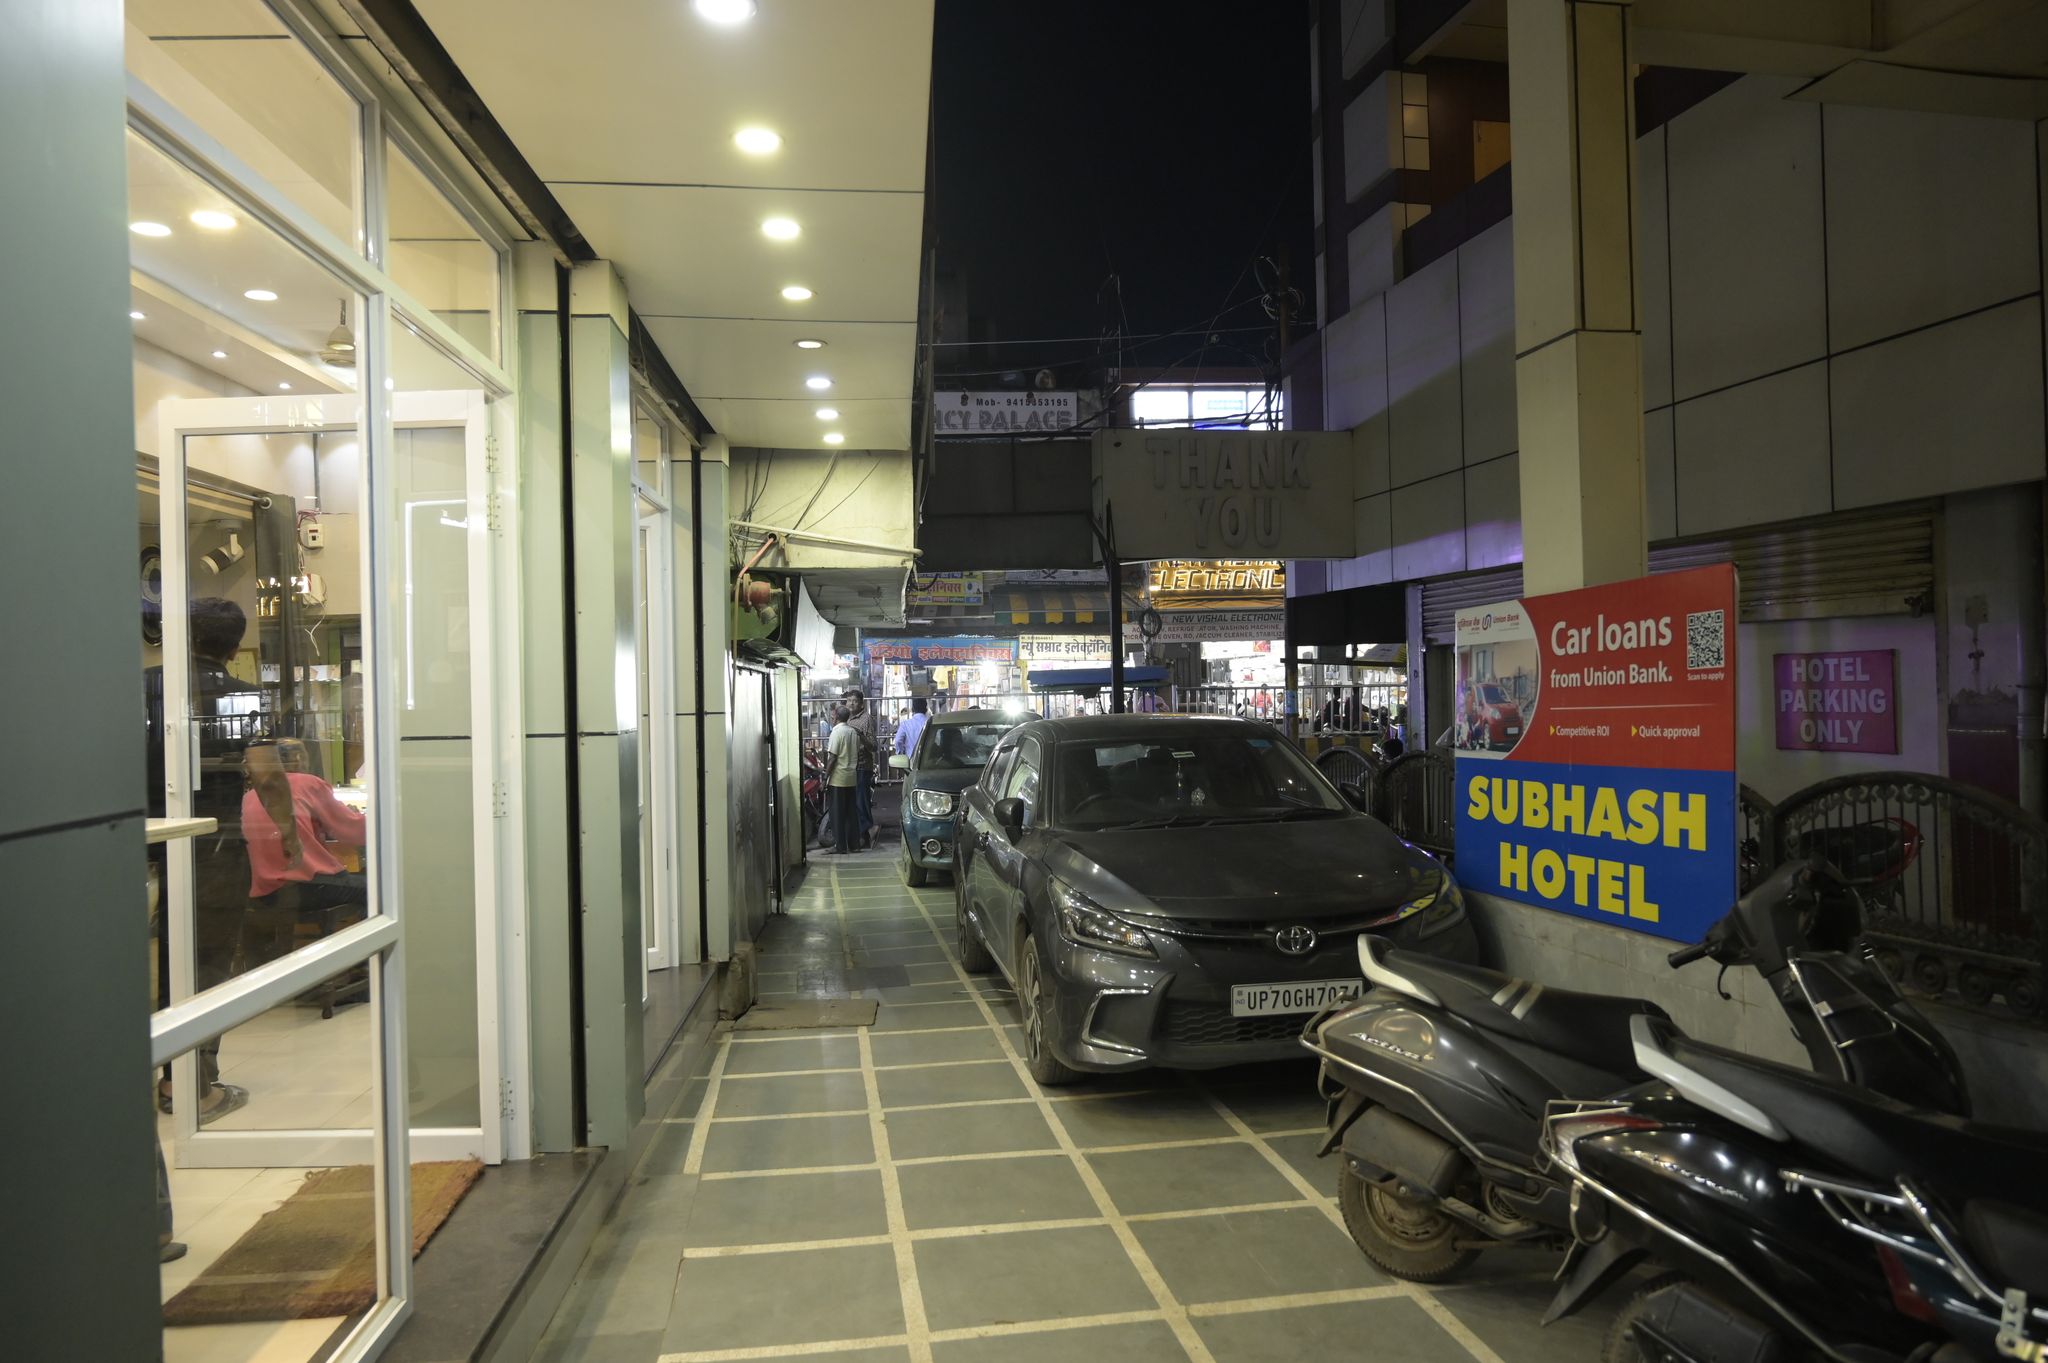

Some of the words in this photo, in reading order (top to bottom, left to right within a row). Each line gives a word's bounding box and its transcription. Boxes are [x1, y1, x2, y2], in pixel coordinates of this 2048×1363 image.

[979, 409, 1073, 431] PALACE
[1144, 437, 1311, 489] THANK
[1187, 496, 1283, 549] YOU
[1172, 615, 1195, 623] NEW
[1197, 614, 1228, 622] VISHAL
[1551, 621, 1591, 656] Car
[1597, 614, 1673, 652] loans
[1550, 669, 1580, 688] from
[1584, 667, 1625, 687] Union
[1629, 661, 1673, 684] Bank.
[1687, 673, 1700, 681] Scan
[1708, 672, 1725, 681] apply
[1791, 657, 1870, 682] HOTEL
[1780, 688, 1887, 714] PARKING
[1556, 725, 1595, 738] Competitive
[1597, 725, 1610, 737] ROI
[1639, 725, 1661, 738] Quick
[1662, 725, 1700, 739] approval
[1800, 718, 1864, 744] ONLY
[1467, 775, 1707, 851] SUBHASH
[1499, 841, 1659, 923] HOTEL
